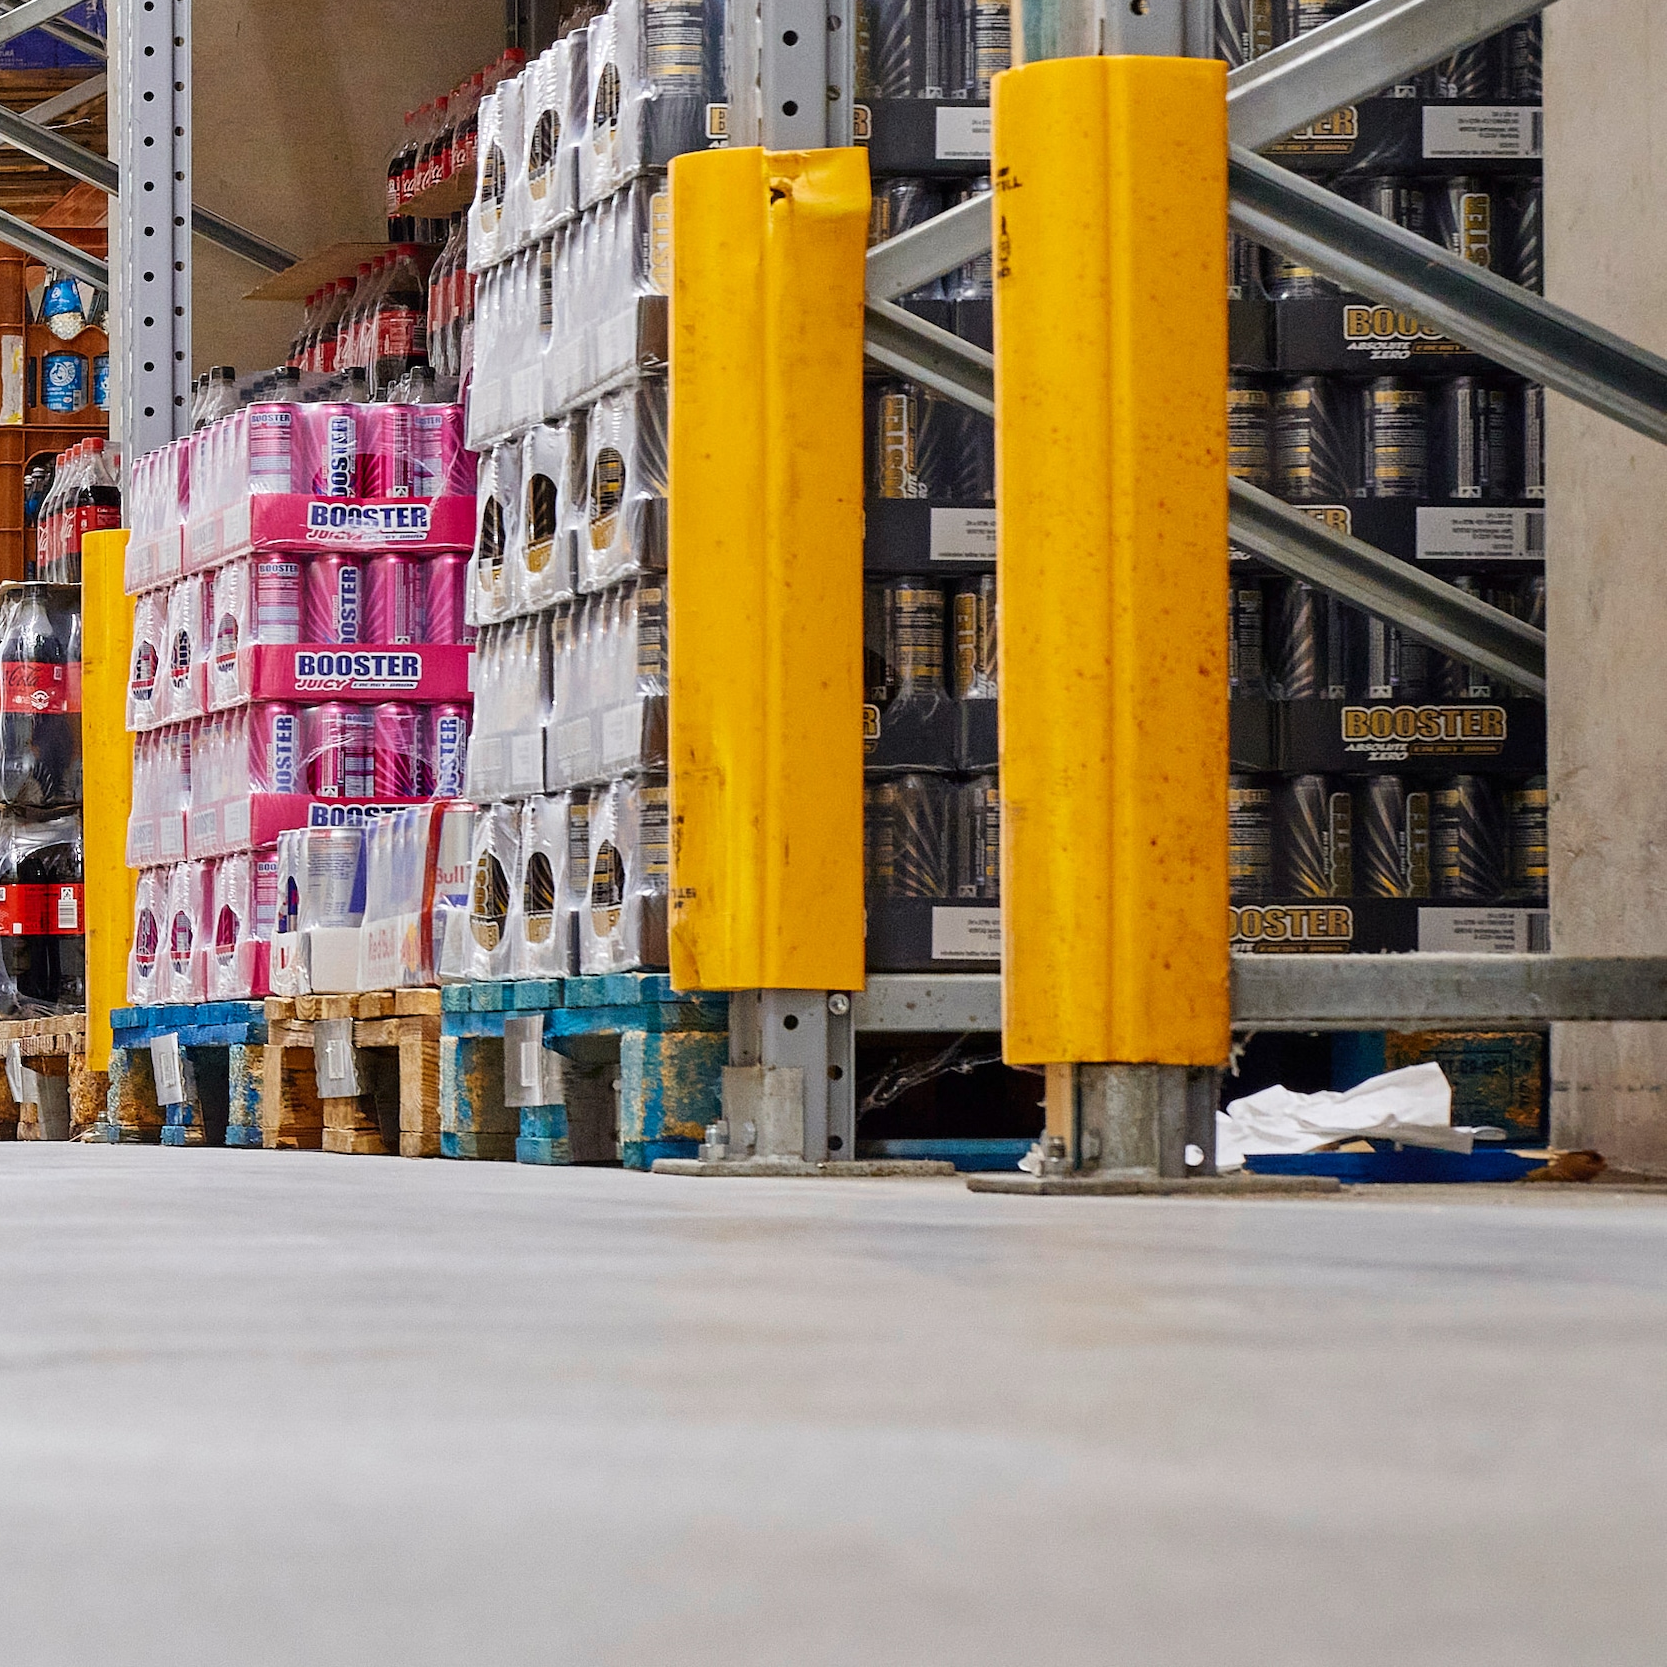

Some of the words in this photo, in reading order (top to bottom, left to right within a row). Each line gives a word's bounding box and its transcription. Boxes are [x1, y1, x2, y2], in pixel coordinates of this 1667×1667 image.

[1347, 342, 1410, 350] ABSOLUTE
[1370, 351, 1410, 359] ZERO
[251, 413, 291, 425] BOOSTER
[309, 504, 430, 529] BOOSTER
[259, 564, 298, 575] BOOSTER
[297, 655, 419, 677] BOOSTER
[296, 679, 348, 690] JUICY
[1345, 709, 1504, 738] BOOSTER
[1345, 743, 1408, 751] ABSOLUTE
[276, 716, 294, 793] OOSTER
[440, 719, 457, 796] OOSTER
[1368, 752, 1408, 760] ZERO
[1229, 908, 1351, 939] OSTER
